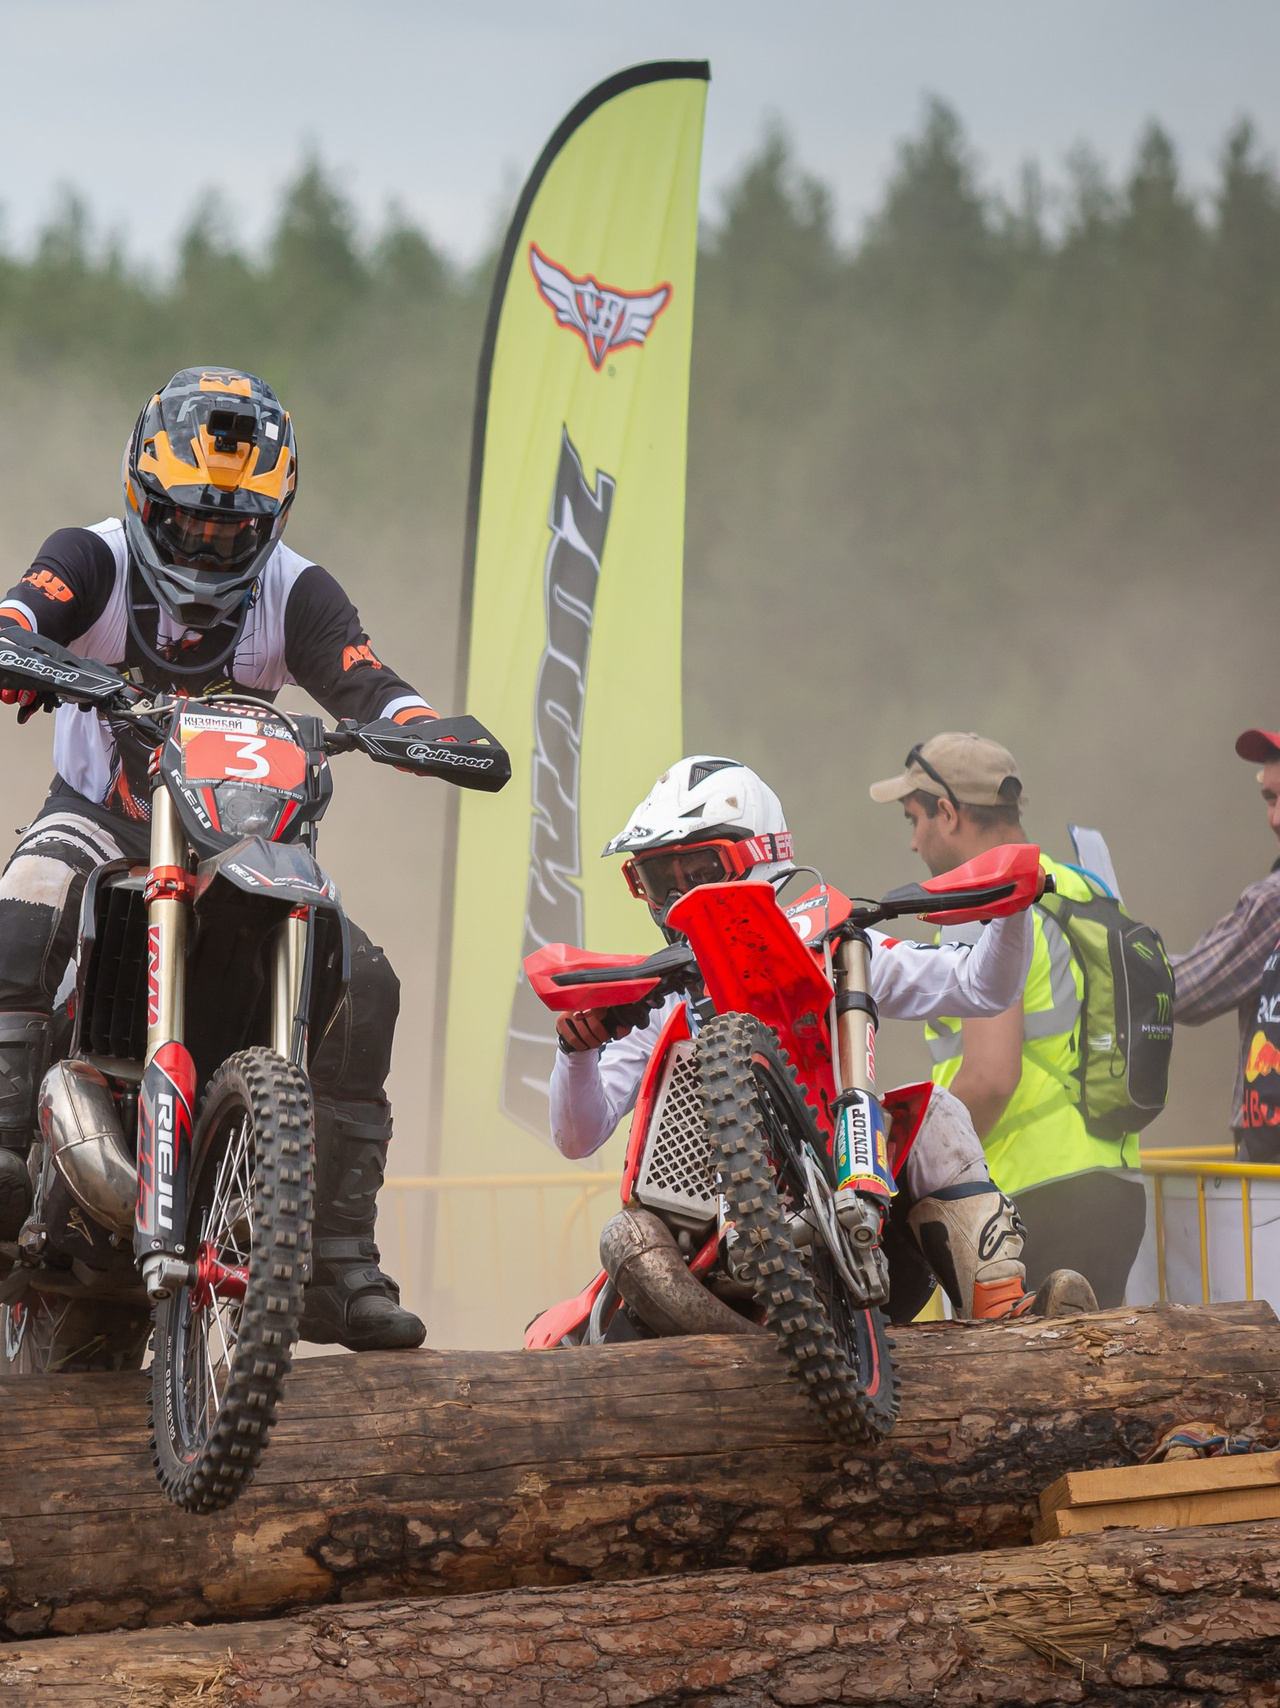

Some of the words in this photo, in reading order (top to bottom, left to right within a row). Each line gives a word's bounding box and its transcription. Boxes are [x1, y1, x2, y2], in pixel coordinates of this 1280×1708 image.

[184, 716, 243, 730] КУЗЯМБАЙ
[224, 734, 271, 780] 3
[406, 743, 494, 769] Polisport
[227, 863, 260, 886] RIEJU
[852, 1107, 870, 1166] DUNLOP
[157, 1092, 173, 1231] RIEJU
